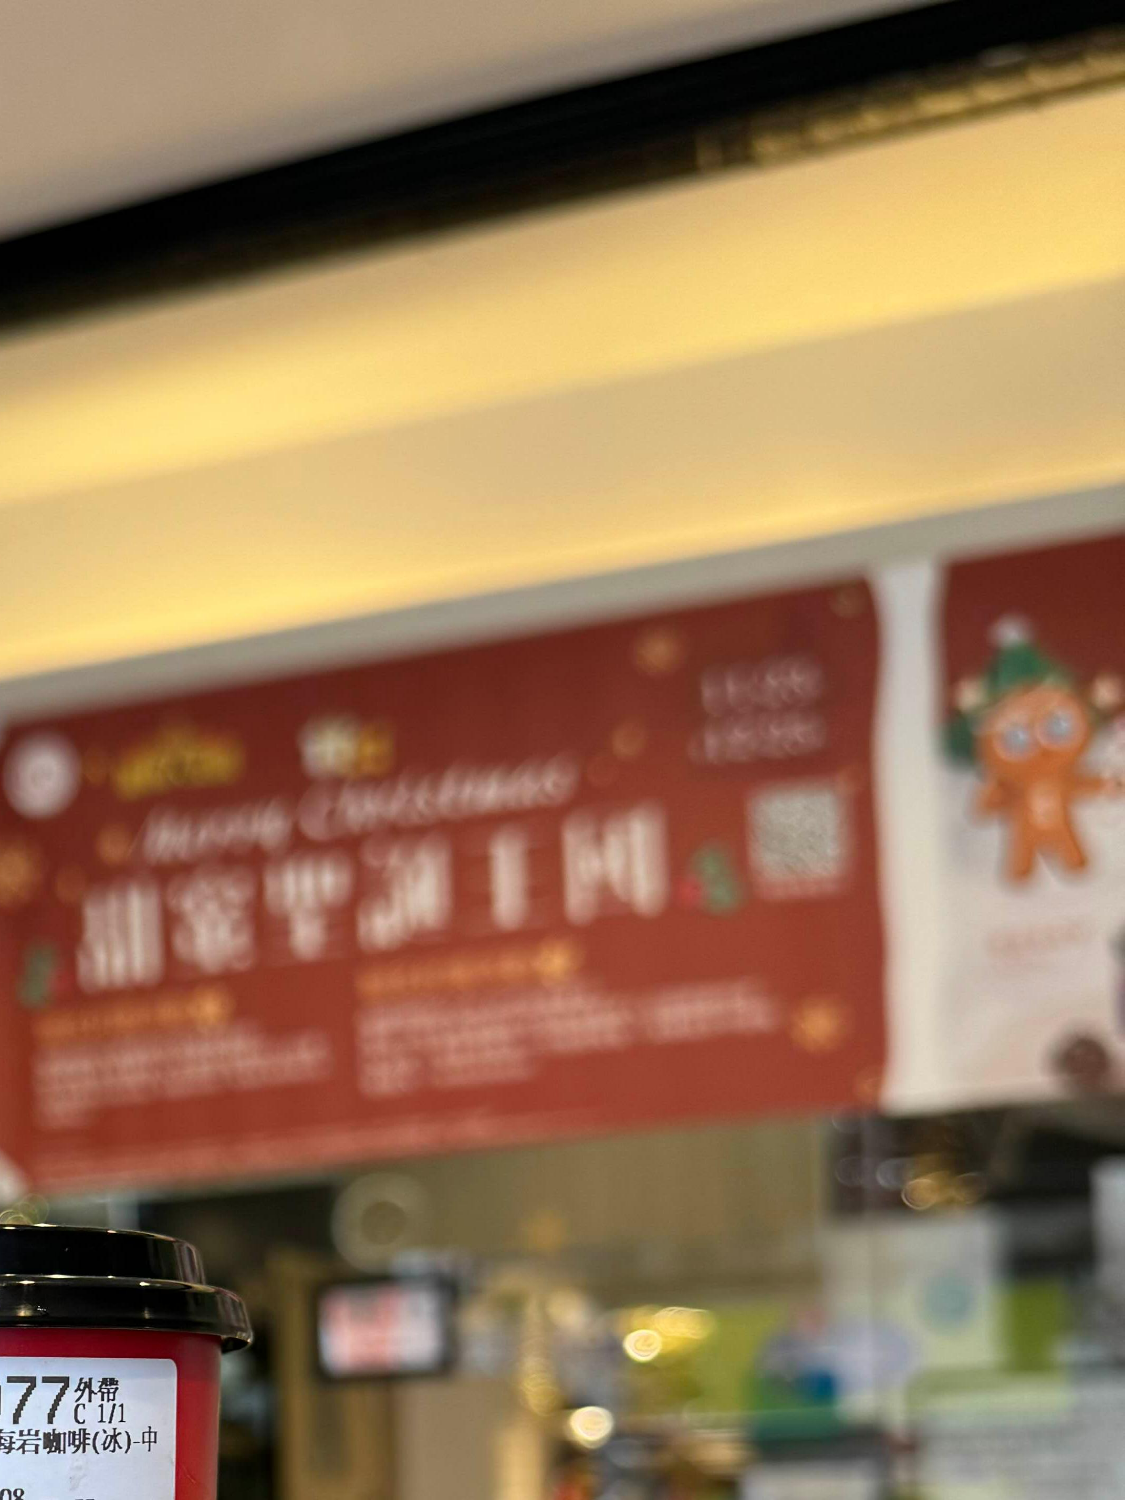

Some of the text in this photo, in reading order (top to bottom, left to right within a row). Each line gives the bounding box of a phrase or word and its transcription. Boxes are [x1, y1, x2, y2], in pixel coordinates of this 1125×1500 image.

[74, 1377, 119, 1402] 外帶
[74, 1403, 126, 1424] C 1/1
